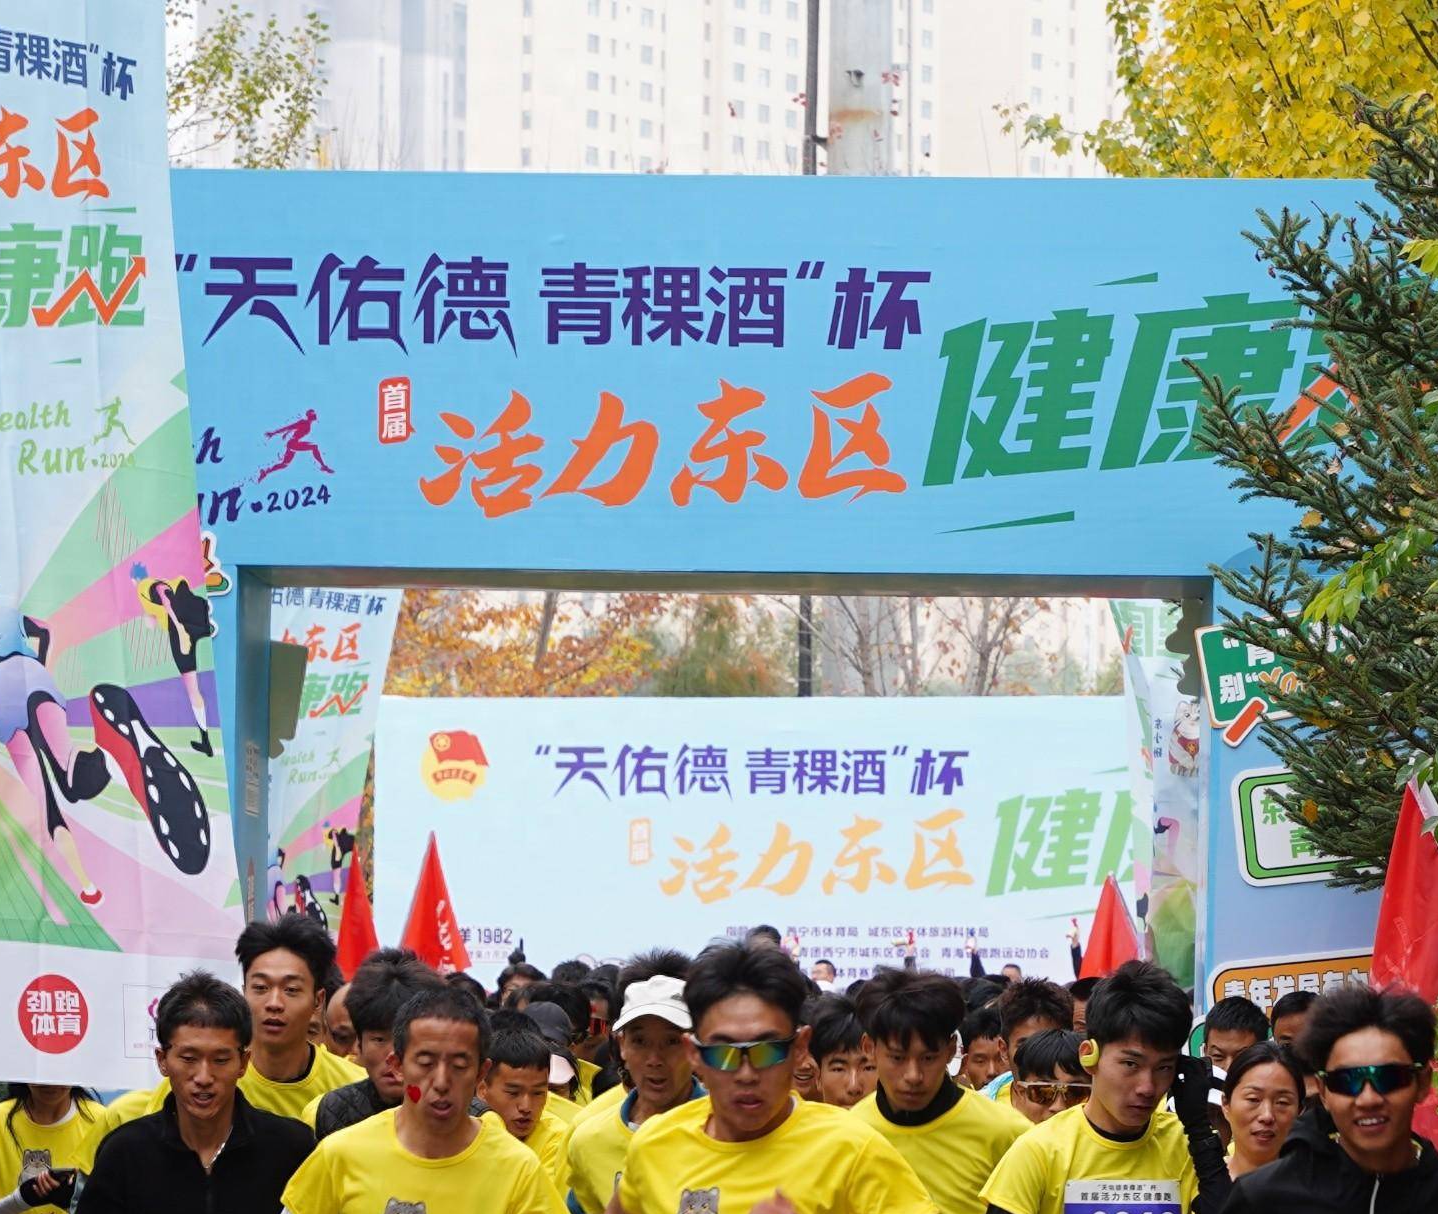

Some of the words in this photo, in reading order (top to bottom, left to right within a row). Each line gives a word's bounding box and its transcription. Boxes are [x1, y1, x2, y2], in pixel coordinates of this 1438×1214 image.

[381, 384, 407, 441] 首届
[920, 284, 1391, 488] 健康
[417, 371, 907, 519] 活力东区
[659, 810, 978, 904] 活力东区
[26, 990, 81, 1014] 劲跑
[31, 1013, 82, 1037] 体育
